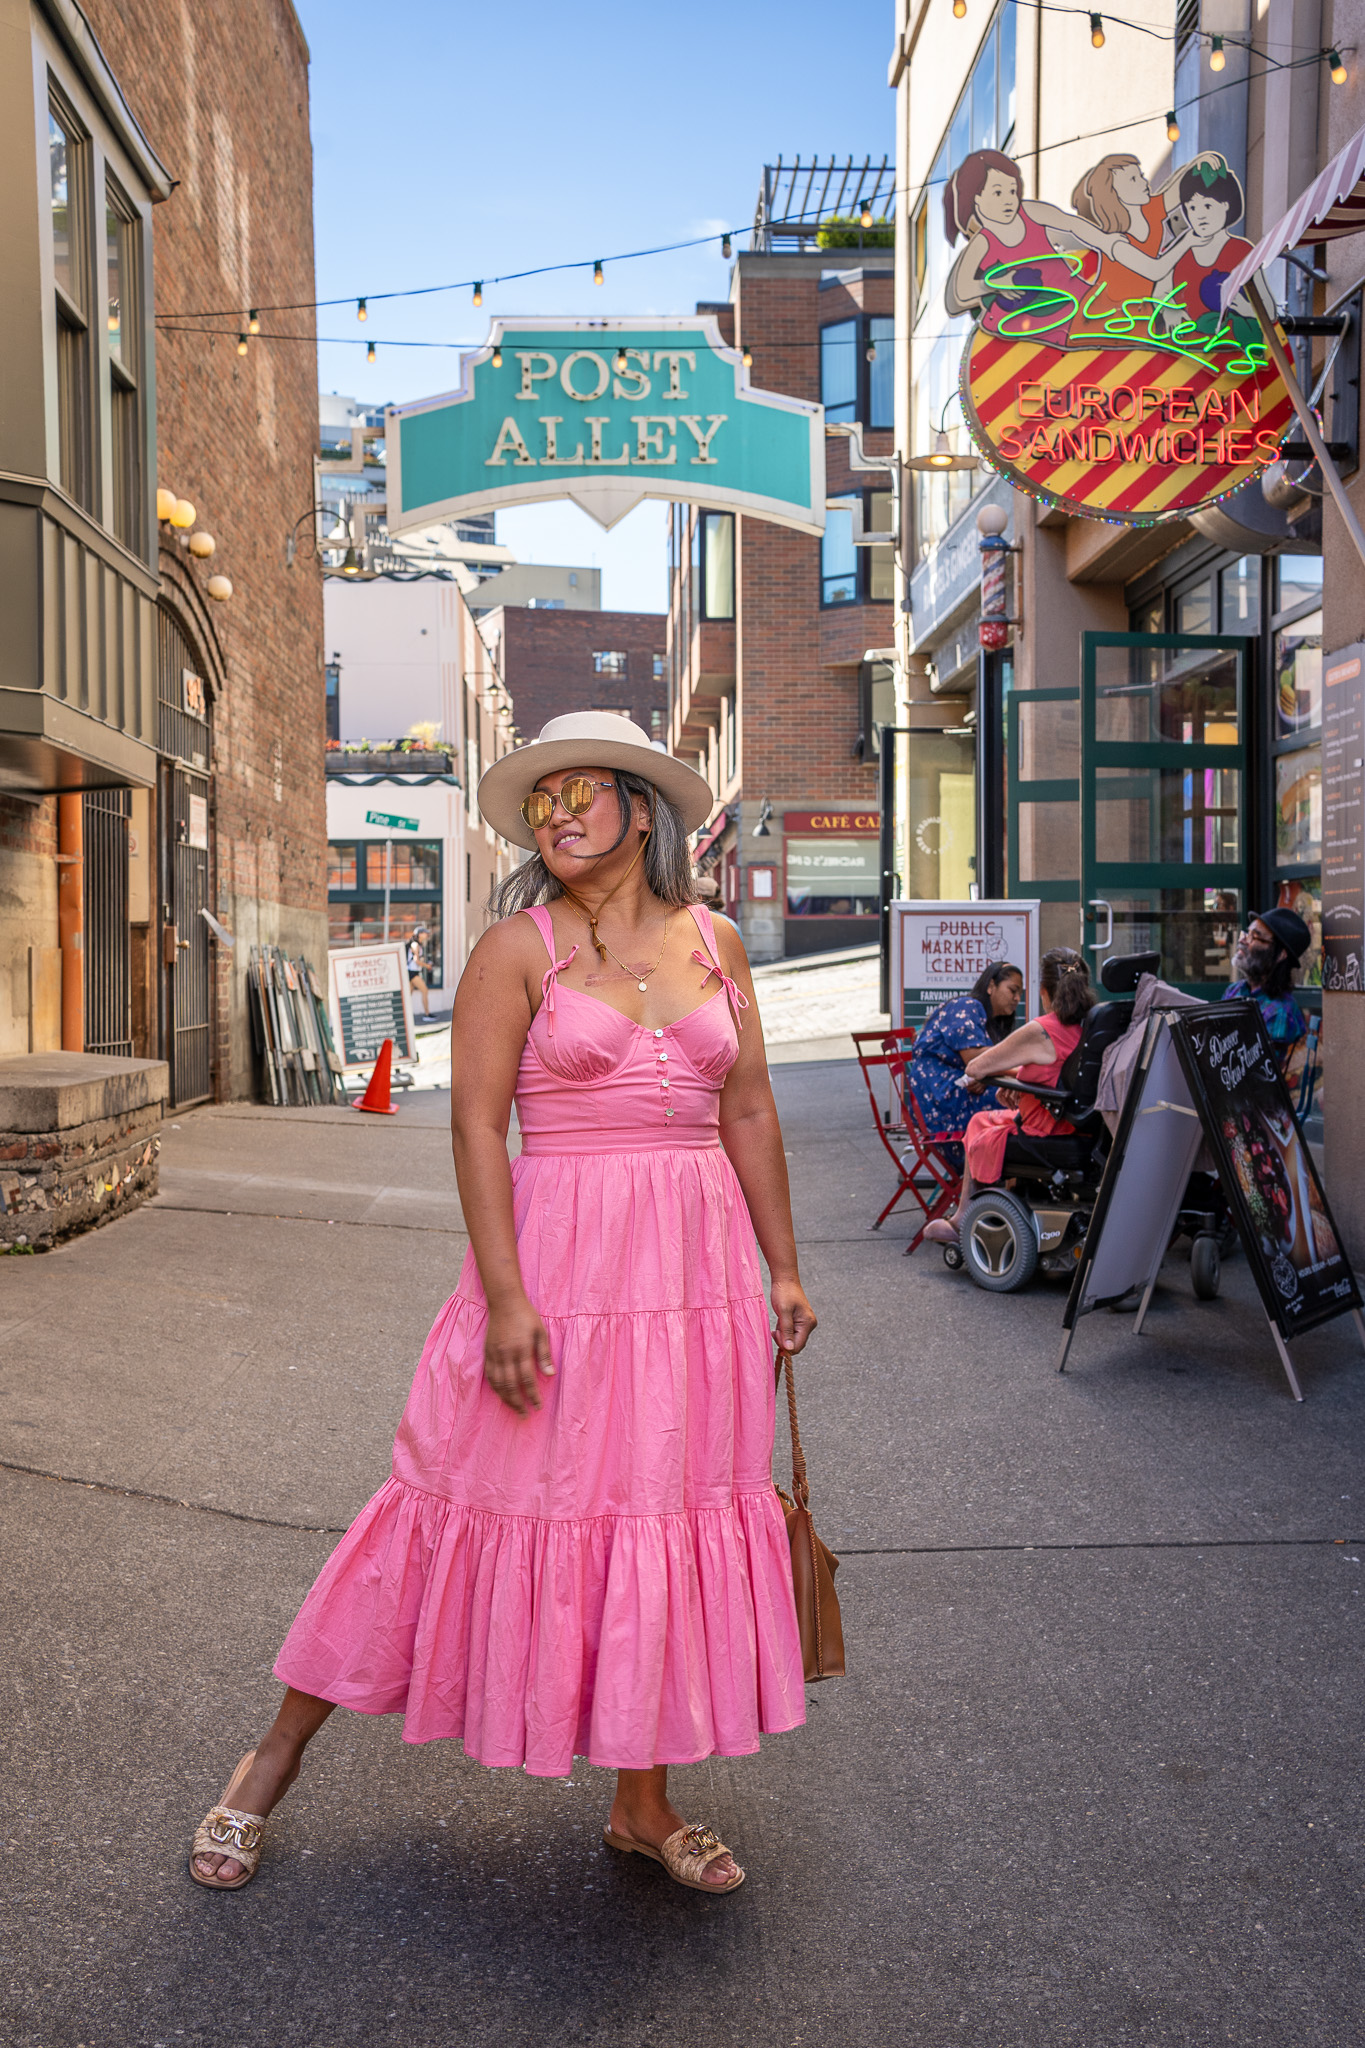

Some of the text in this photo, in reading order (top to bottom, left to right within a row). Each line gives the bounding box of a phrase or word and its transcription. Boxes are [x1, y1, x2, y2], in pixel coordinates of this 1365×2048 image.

[984, 253, 1269, 374] Sisters
[515, 349, 697, 401] POST
[1017, 380, 1261, 424] EUROPEAN
[484, 414, 729, 466] ALLEY
[998, 423, 1282, 466] SANDWICHES
[810, 814, 850, 829] CAFÉ
[940, 921, 995, 936] PUBLIC
[921, 939, 984, 954] MARKET
[353, 957, 383, 968] PUBLIC
[345, 967, 378, 979] MARKET
[351, 976, 385, 988] CENTER
[1040, 1230, 1061, 1240] C300
